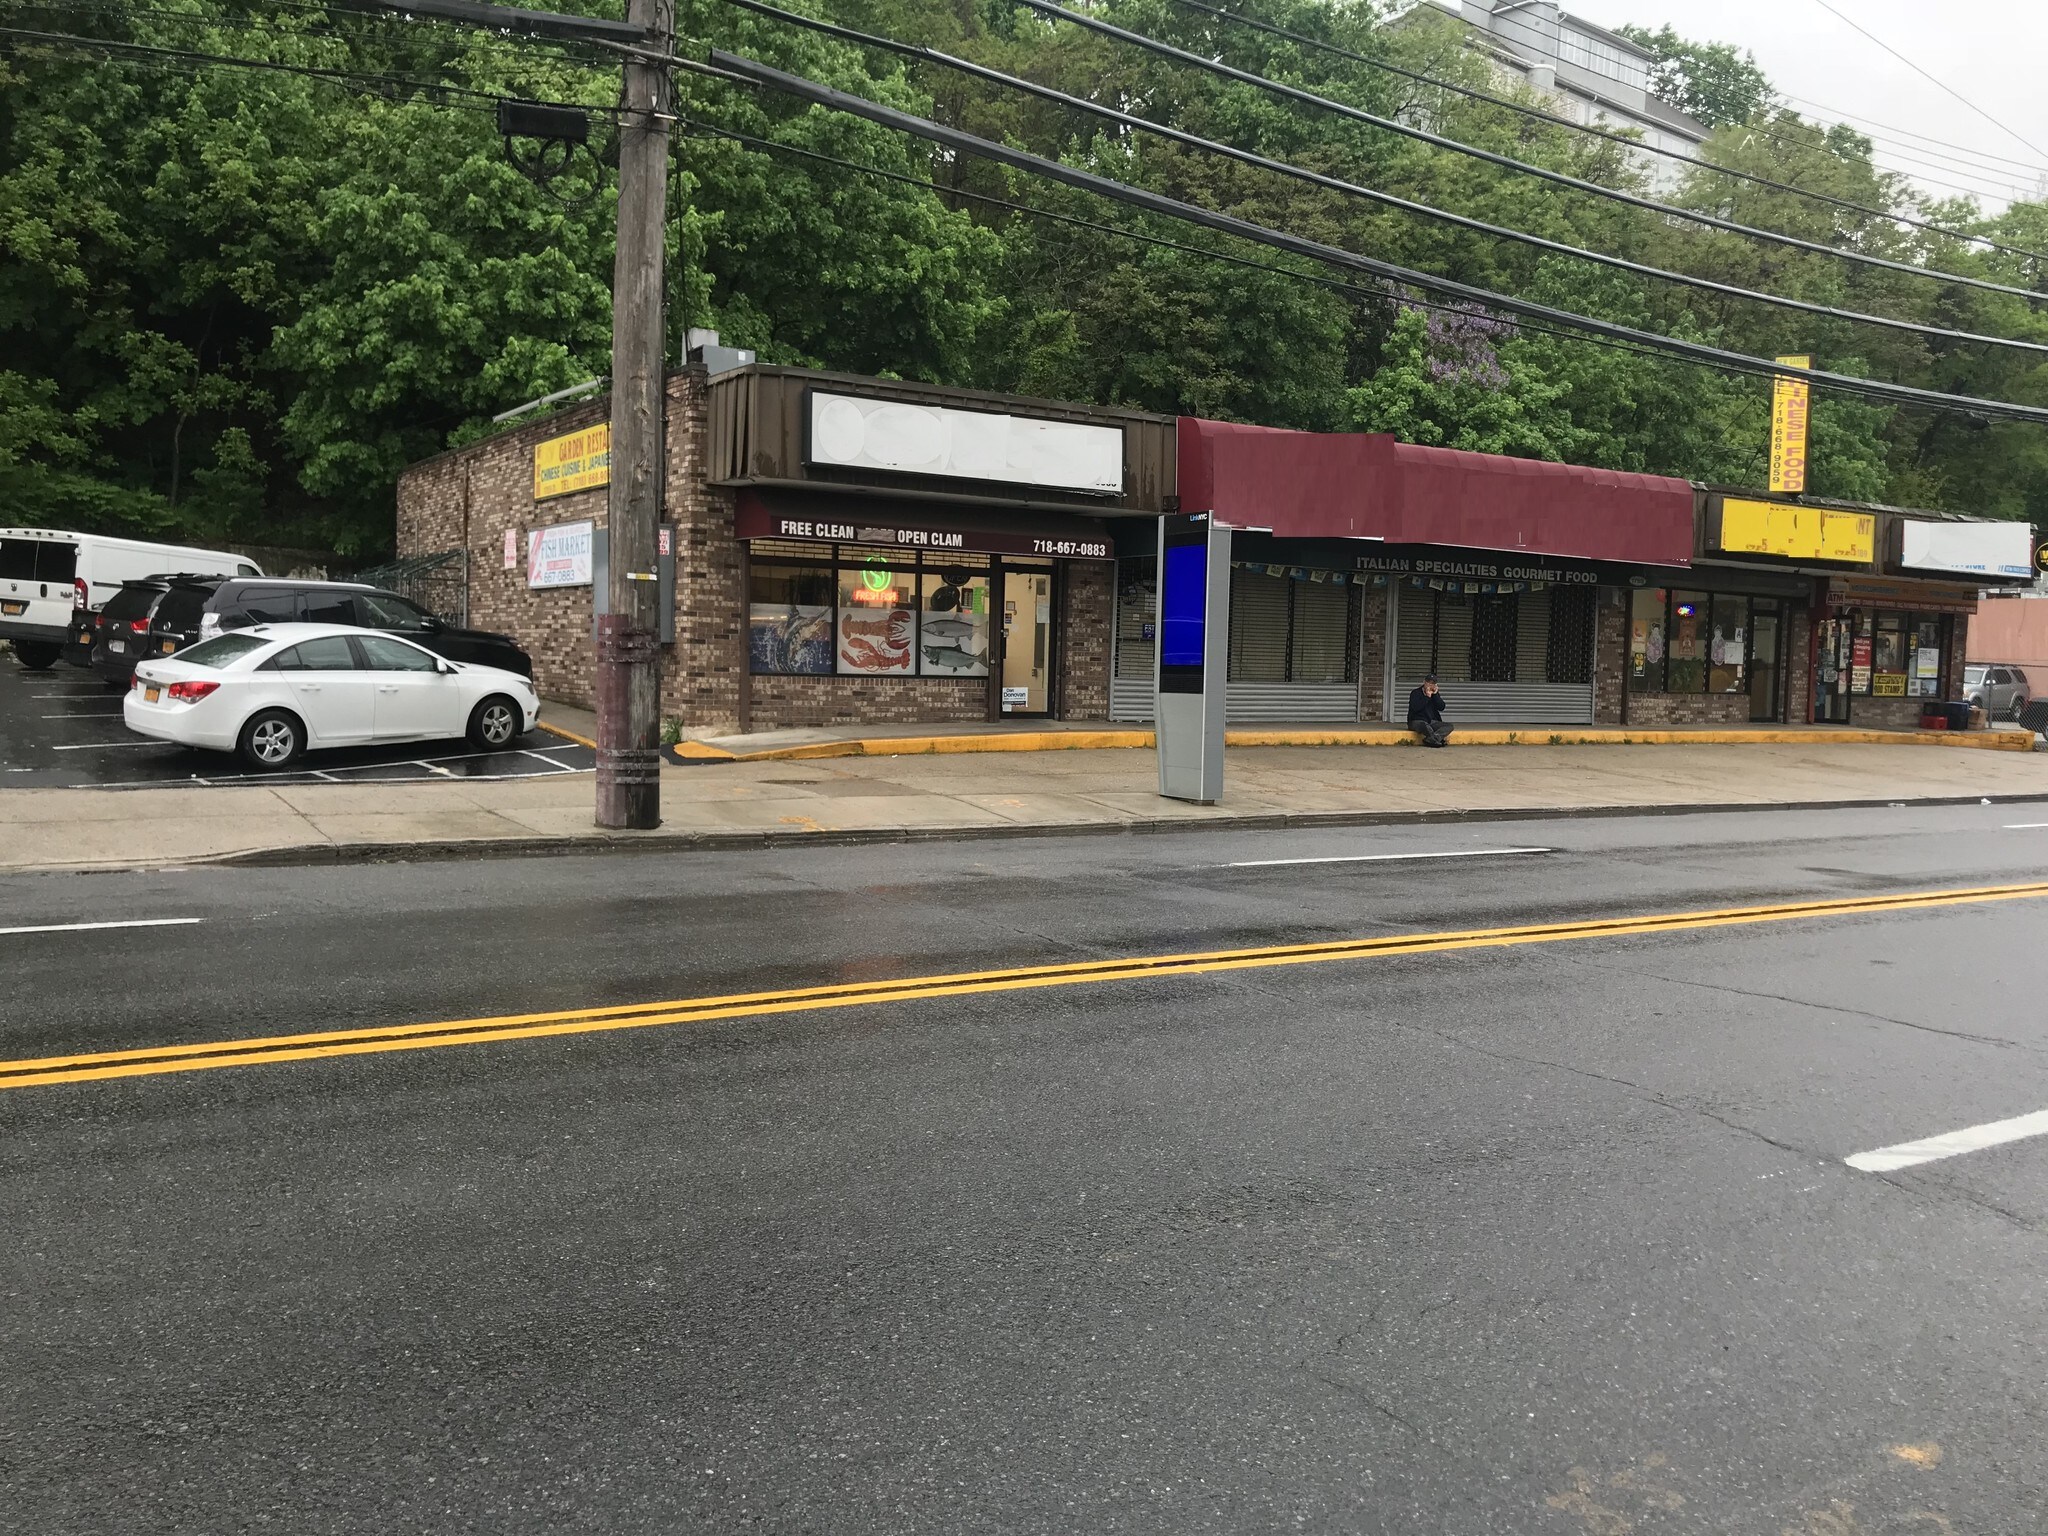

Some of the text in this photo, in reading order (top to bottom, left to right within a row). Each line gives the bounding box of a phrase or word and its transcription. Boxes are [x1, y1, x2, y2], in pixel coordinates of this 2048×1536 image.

[559, 429, 611, 463] GARDEN RESTA
[541, 465, 560, 482] CHINESE
[561, 460, 581, 477] CUISINE
[1784, 447, 1804, 490] FOOD
[1190, 513, 1208, 522] LinkNYC
[781, 520, 812, 536] FREE
[816, 523, 854, 539] CLEAN
[898, 530, 928, 545] OPEN
[931, 532, 963, 547] CLAM
[541, 538, 557, 560] FISH
[558, 533, 591, 558] MARKET
[1033, 540, 1106, 556] 718-667-0883
[544, 570, 575, 583] 667-0883
[1356, 557, 1598, 583] ITALIAN SPECIALTIES GOURMET FOOD
[855, 589, 897, 602] FRESH FISH
[1828, 593, 1844, 603] ATM
